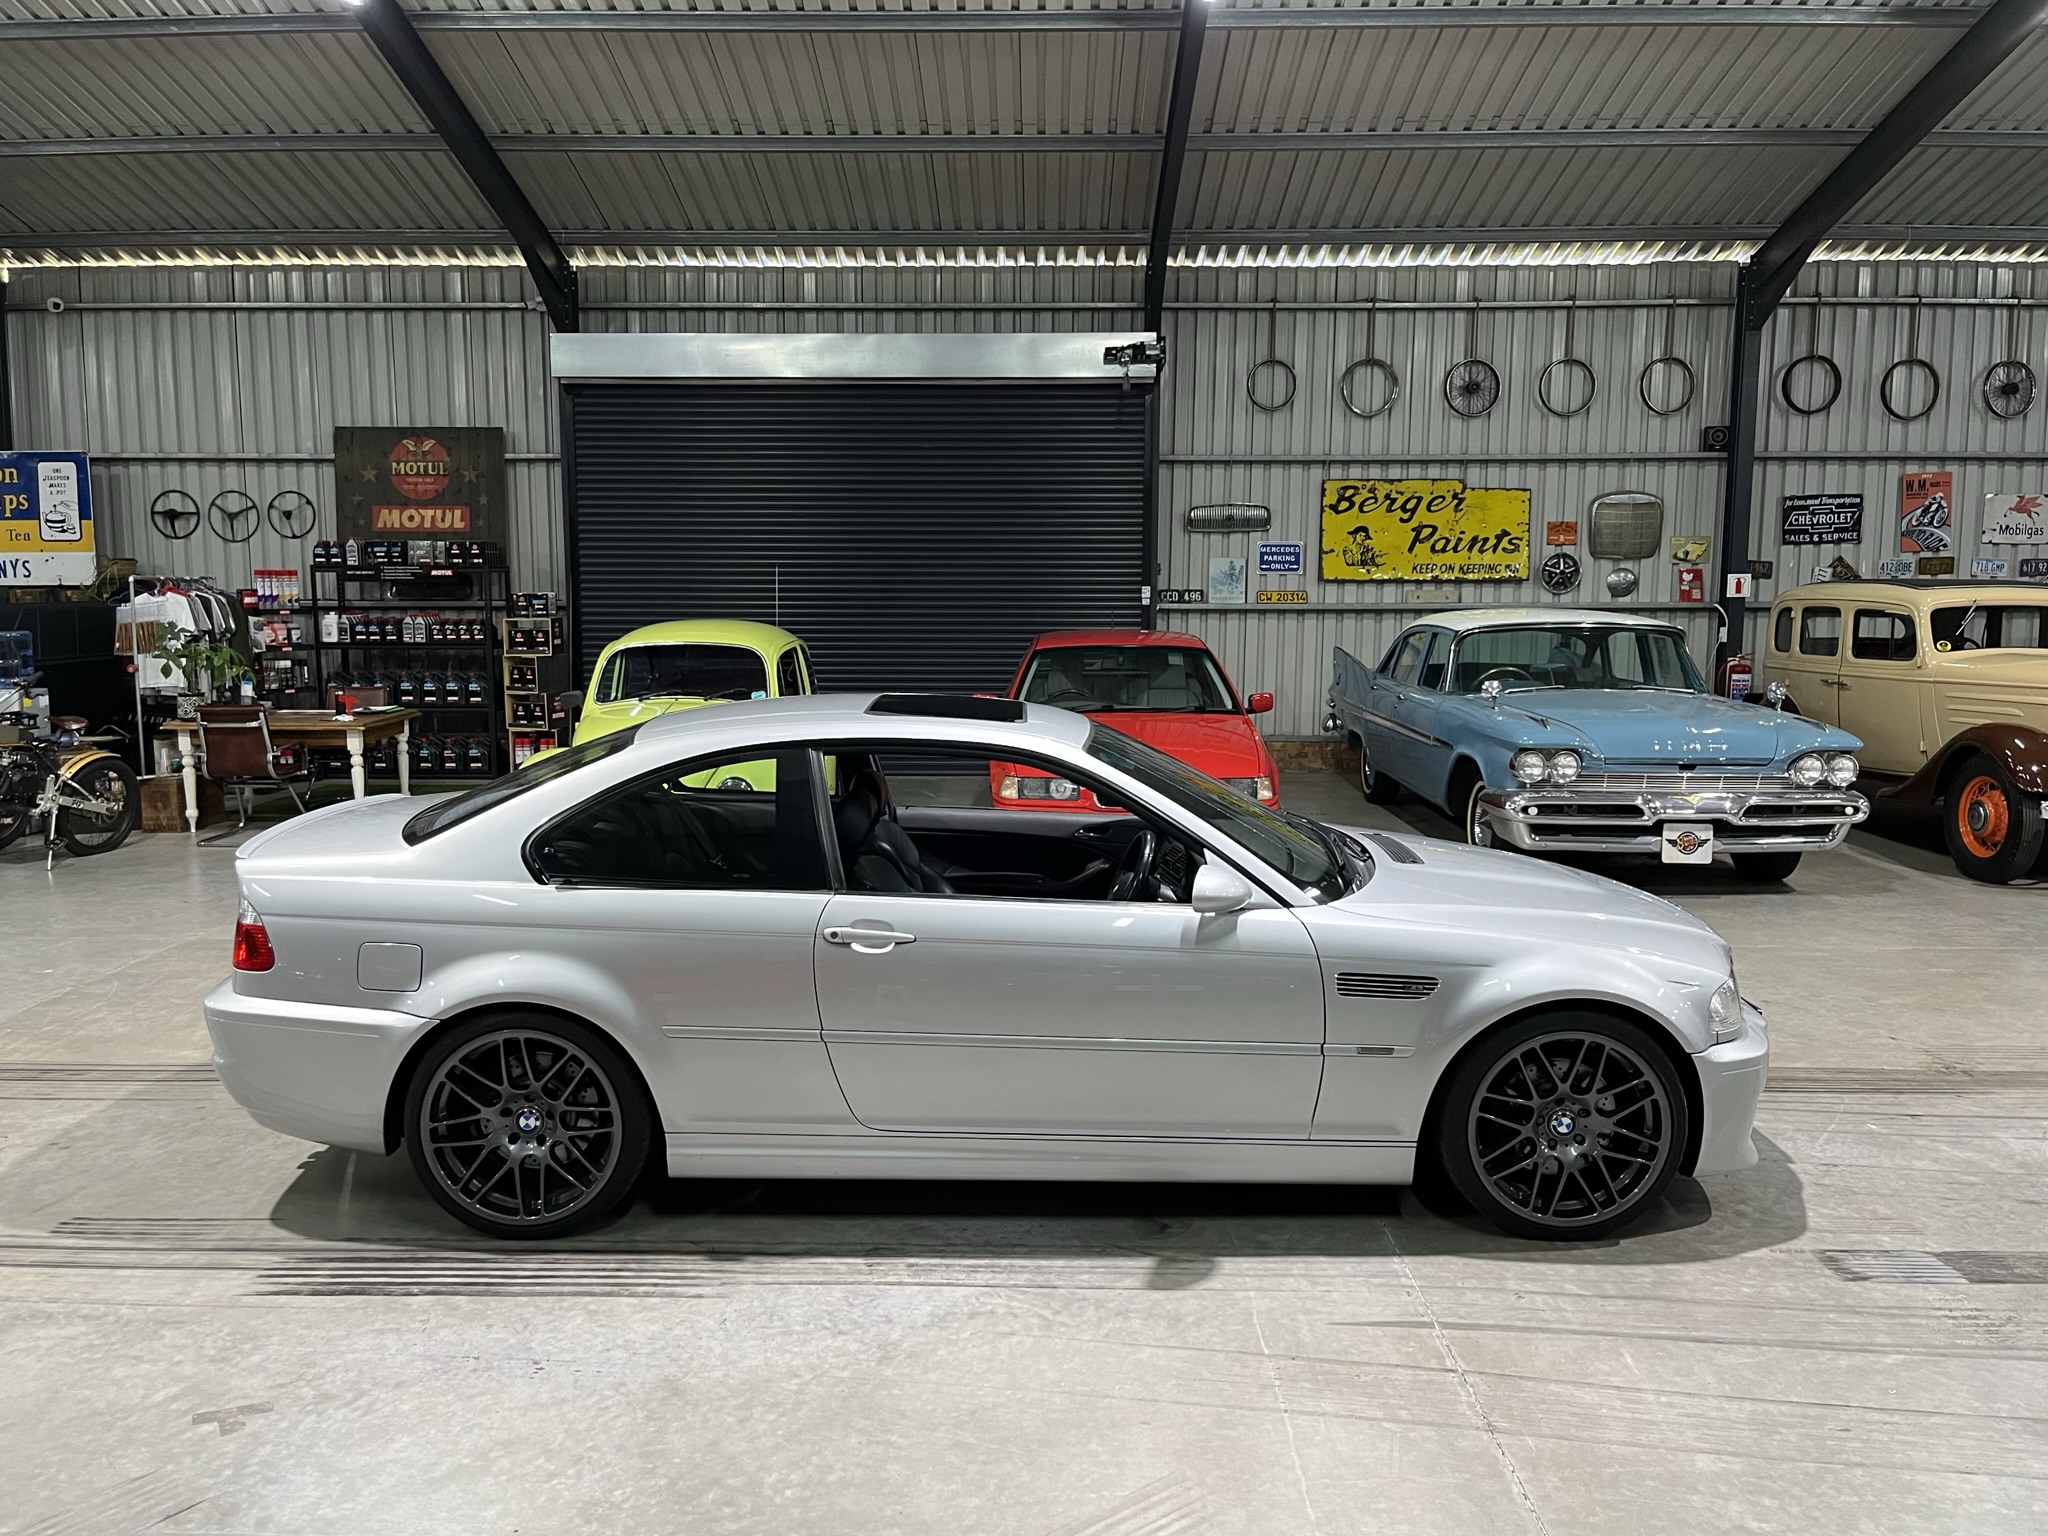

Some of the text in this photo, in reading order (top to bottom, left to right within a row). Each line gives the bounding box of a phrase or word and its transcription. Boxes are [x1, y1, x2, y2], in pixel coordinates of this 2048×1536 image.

[391, 461, 448, 475] MOTUL
[1905, 479, 1929, 493] W.M.
[1328, 484, 1467, 524] Berger
[1784, 499, 1793, 508] for
[1821, 496, 1860, 506] Transportation
[377, 508, 466, 529] MOTUL
[1792, 513, 1852, 525] CHEVROLET
[6, 528, 31, 541] Tea
[1785, 534, 1810, 542] SALES
[1822, 532, 1858, 541] SERVICE
[1998, 523, 2044, 540] Mobilgas
[1407, 523, 1524, 555] Paints
[1411, 562, 1437, 575] KEEP
[1439, 562, 1455, 574] ON
[2023, 562, 2036, 573] 617
[1161, 591, 1178, 601] CCD
[1184, 591, 1202, 601] 496
[1258, 592, 1306, 602] CW 20314
